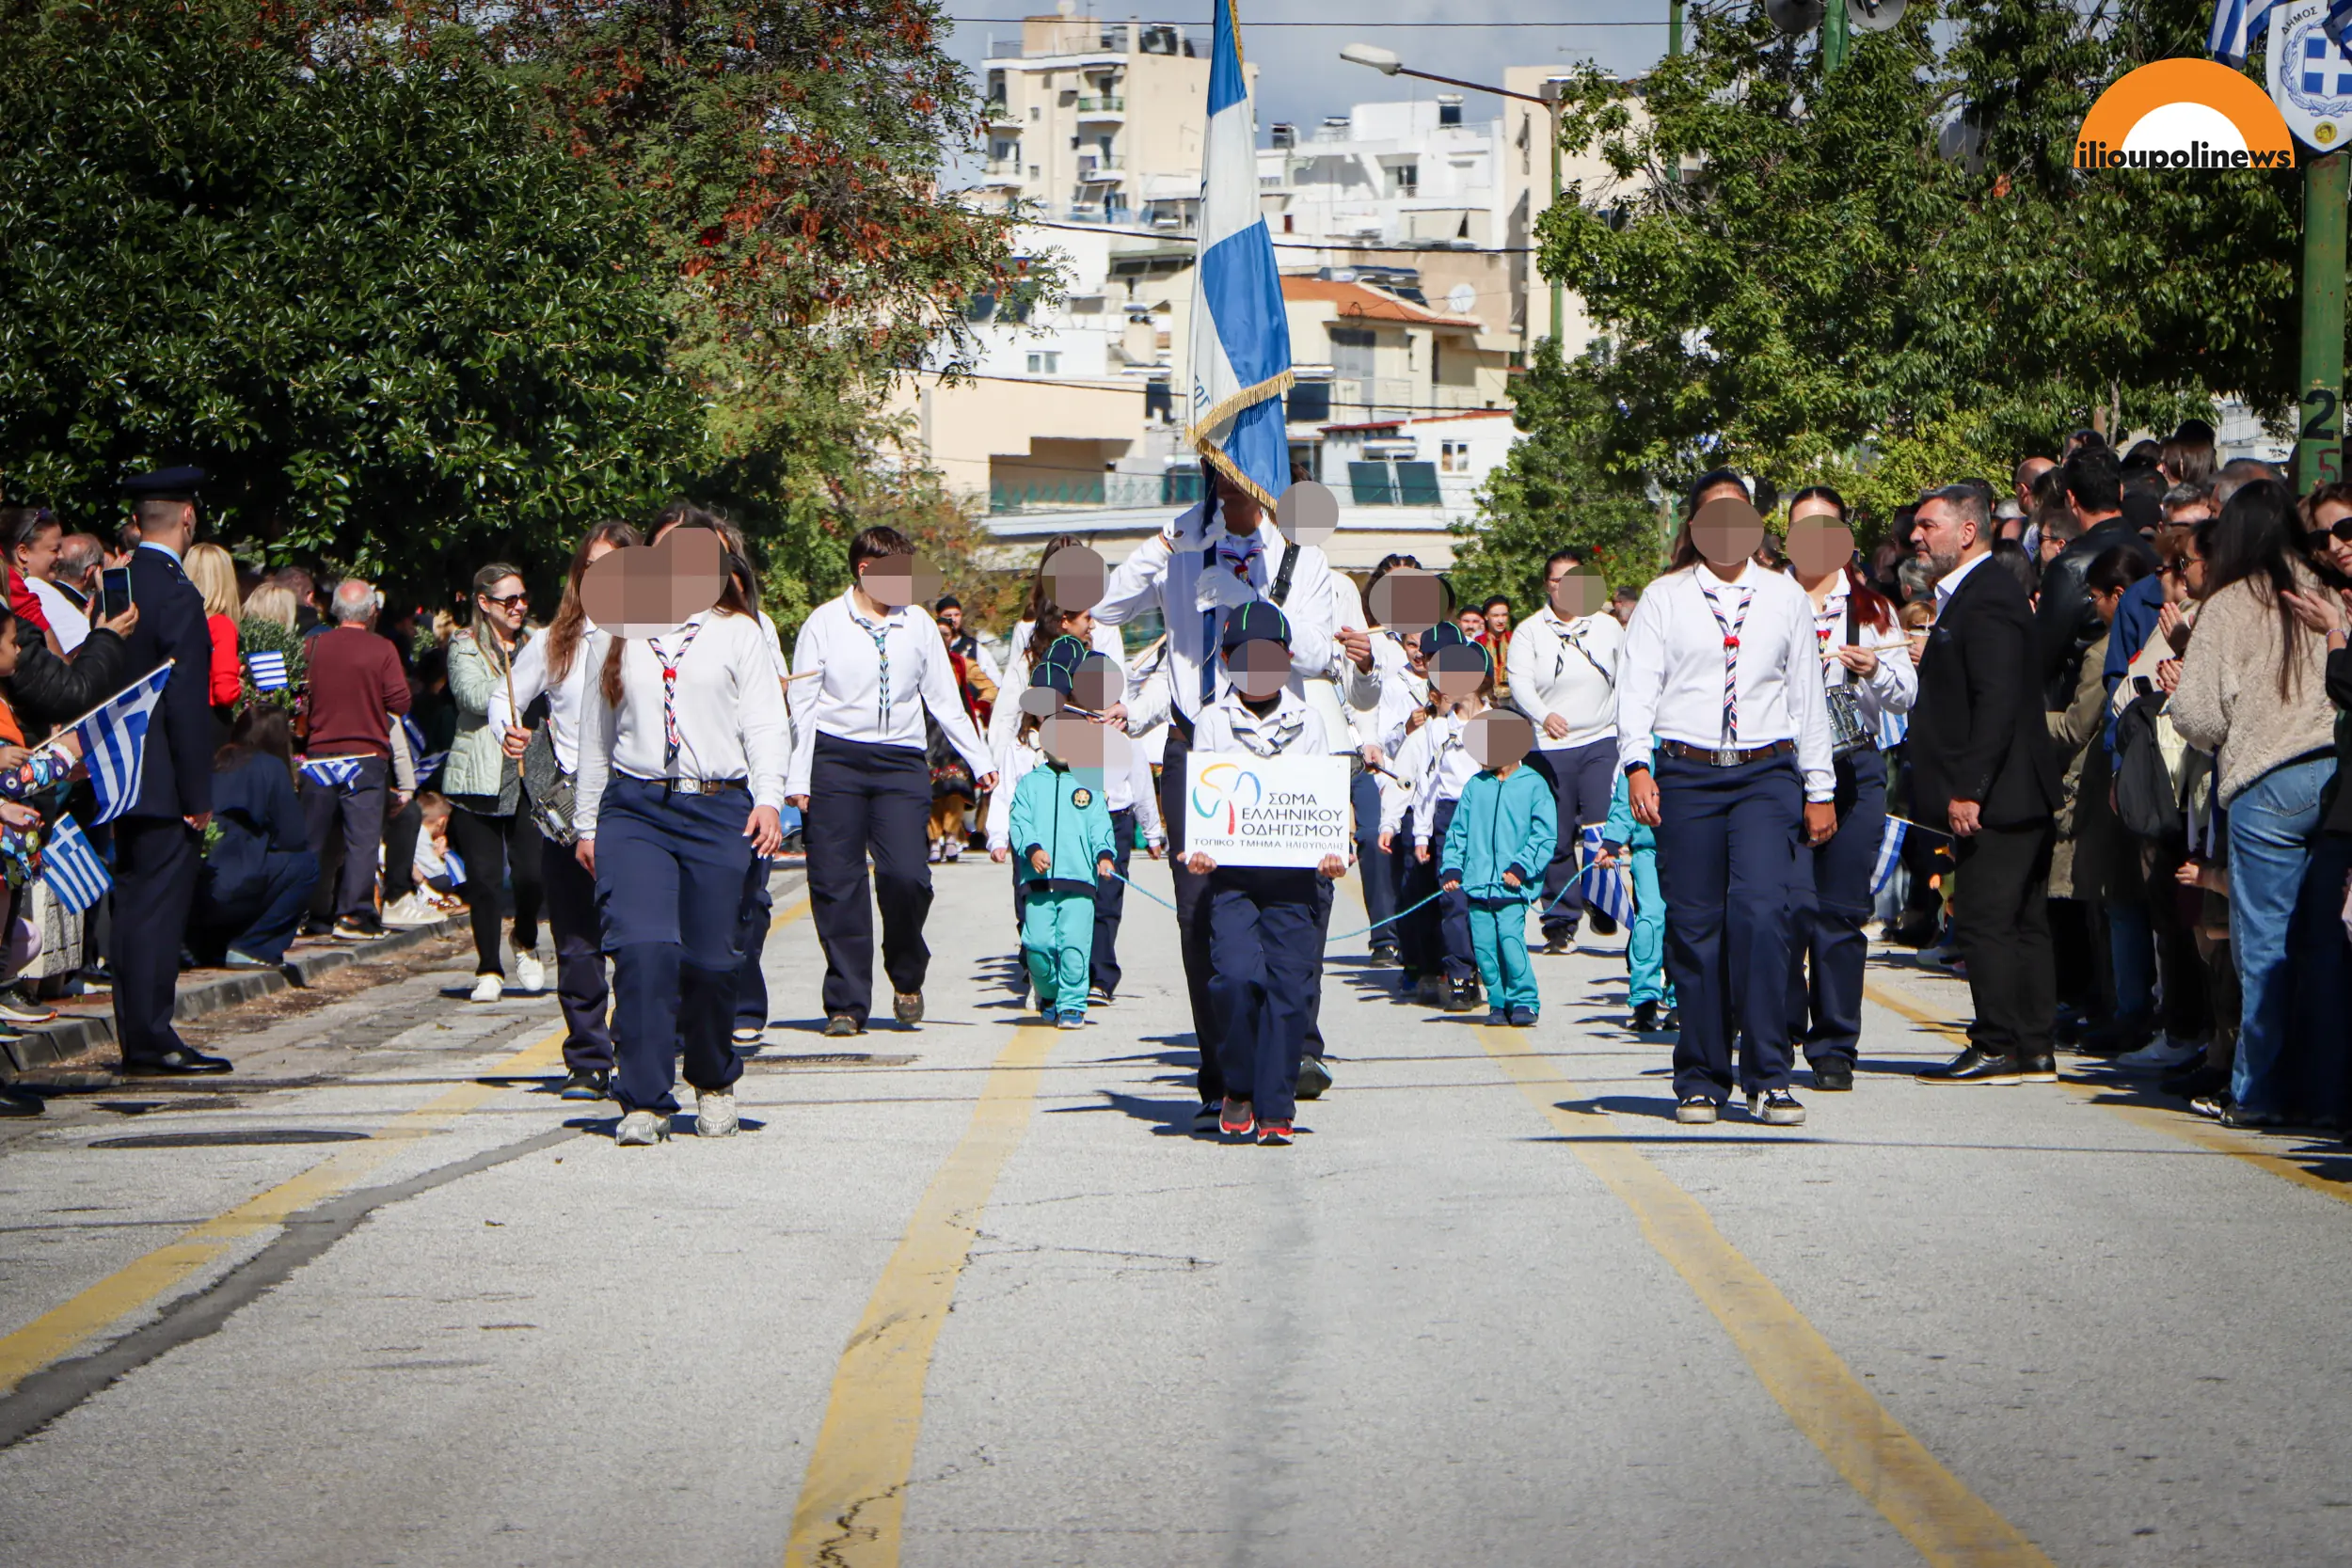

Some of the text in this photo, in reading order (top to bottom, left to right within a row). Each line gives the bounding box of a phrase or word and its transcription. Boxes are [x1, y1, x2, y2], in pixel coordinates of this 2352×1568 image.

[2280, 6, 2318, 36] ΔΗΜΟΣ
[2302, 389, 2336, 440] 2
[1268, 792, 1317, 806] ΣΩΜΑ
[1242, 808, 1343, 822] ΕΛΛΗΝΙΚΟΥ
[1241, 823, 1343, 837] ΟΔΗΓΙΣΜΟΥ
[1193, 837, 1344, 851] ΤΟΠΙΚΟ ΤΜΗΜΑ ΗΛΙΟΥΠΟΛΗΣ
